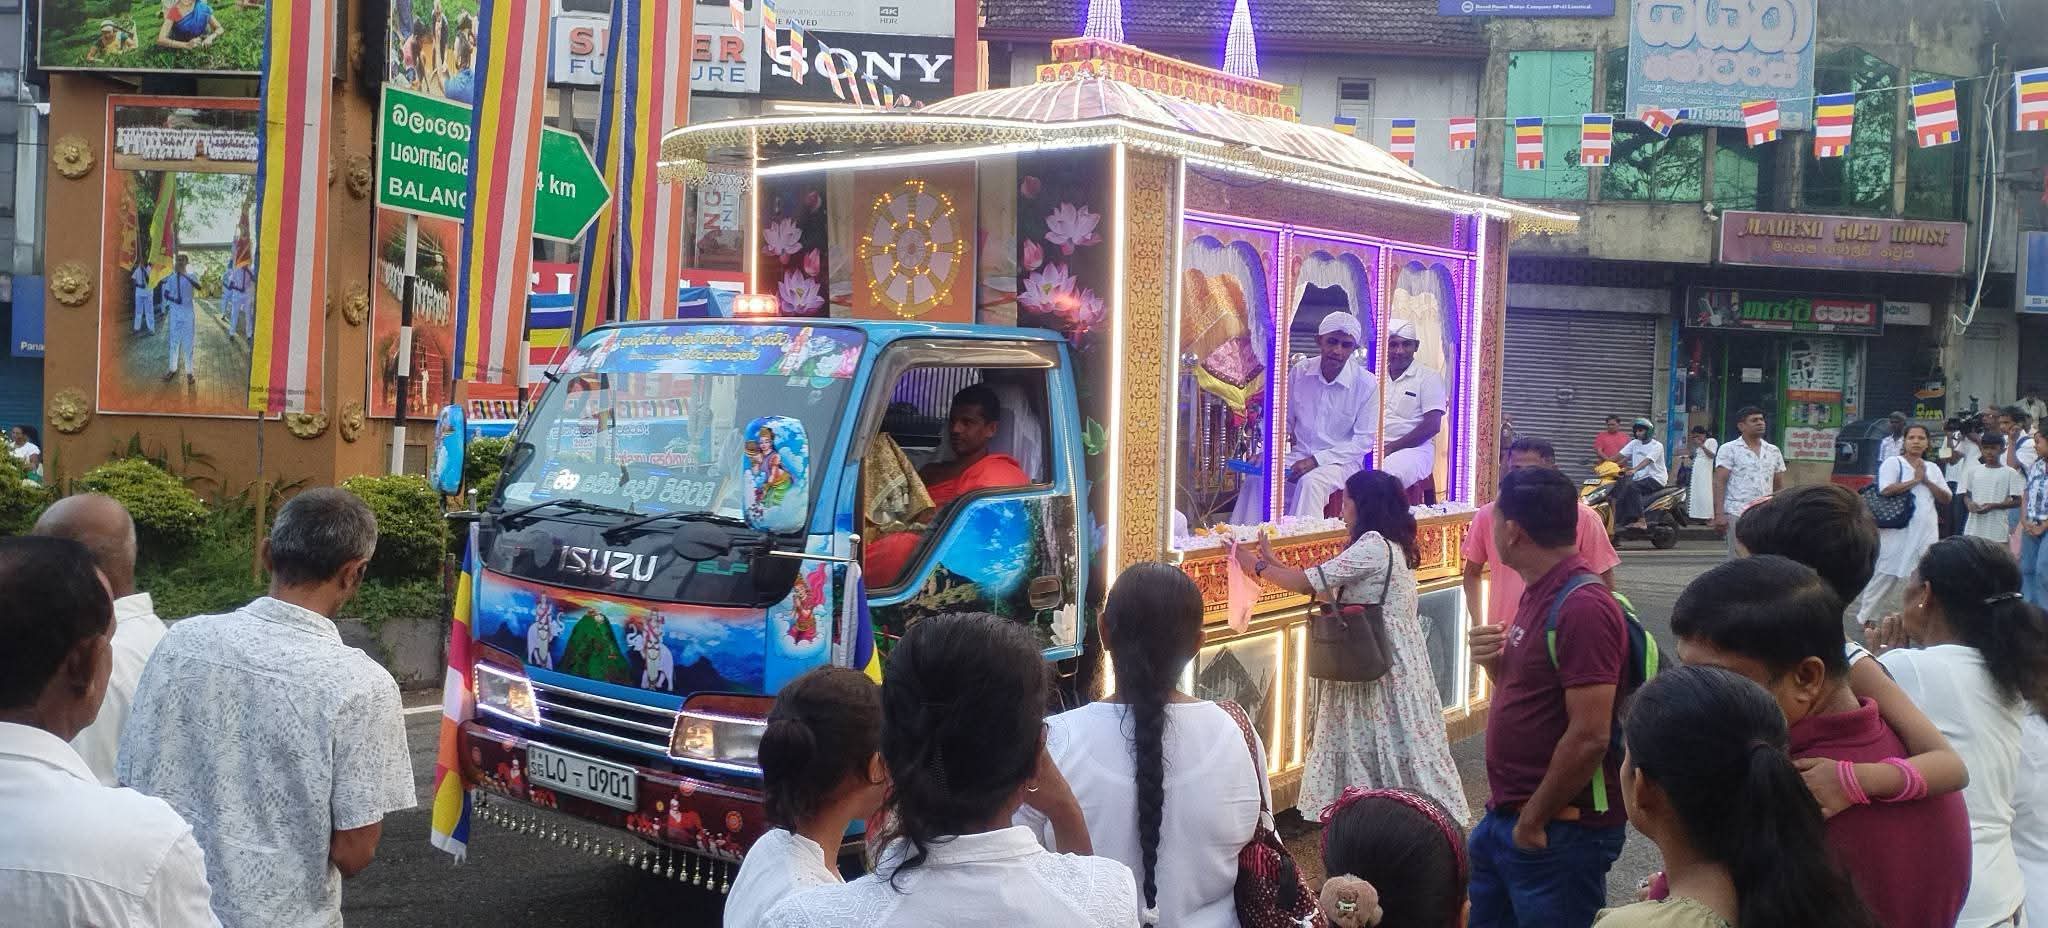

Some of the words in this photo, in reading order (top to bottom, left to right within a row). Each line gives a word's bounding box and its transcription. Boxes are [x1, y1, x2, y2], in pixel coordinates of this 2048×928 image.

[880, 7, 898, 17] 4K
[772, 45, 953, 83] SONY
[392, 104, 472, 141] බලංගො
[550, 174, 576, 199] km
[21, 341, 45, 351] Pana
[559, 545, 658, 582] ISUZU
[588, 766, 632, 800] 0901
